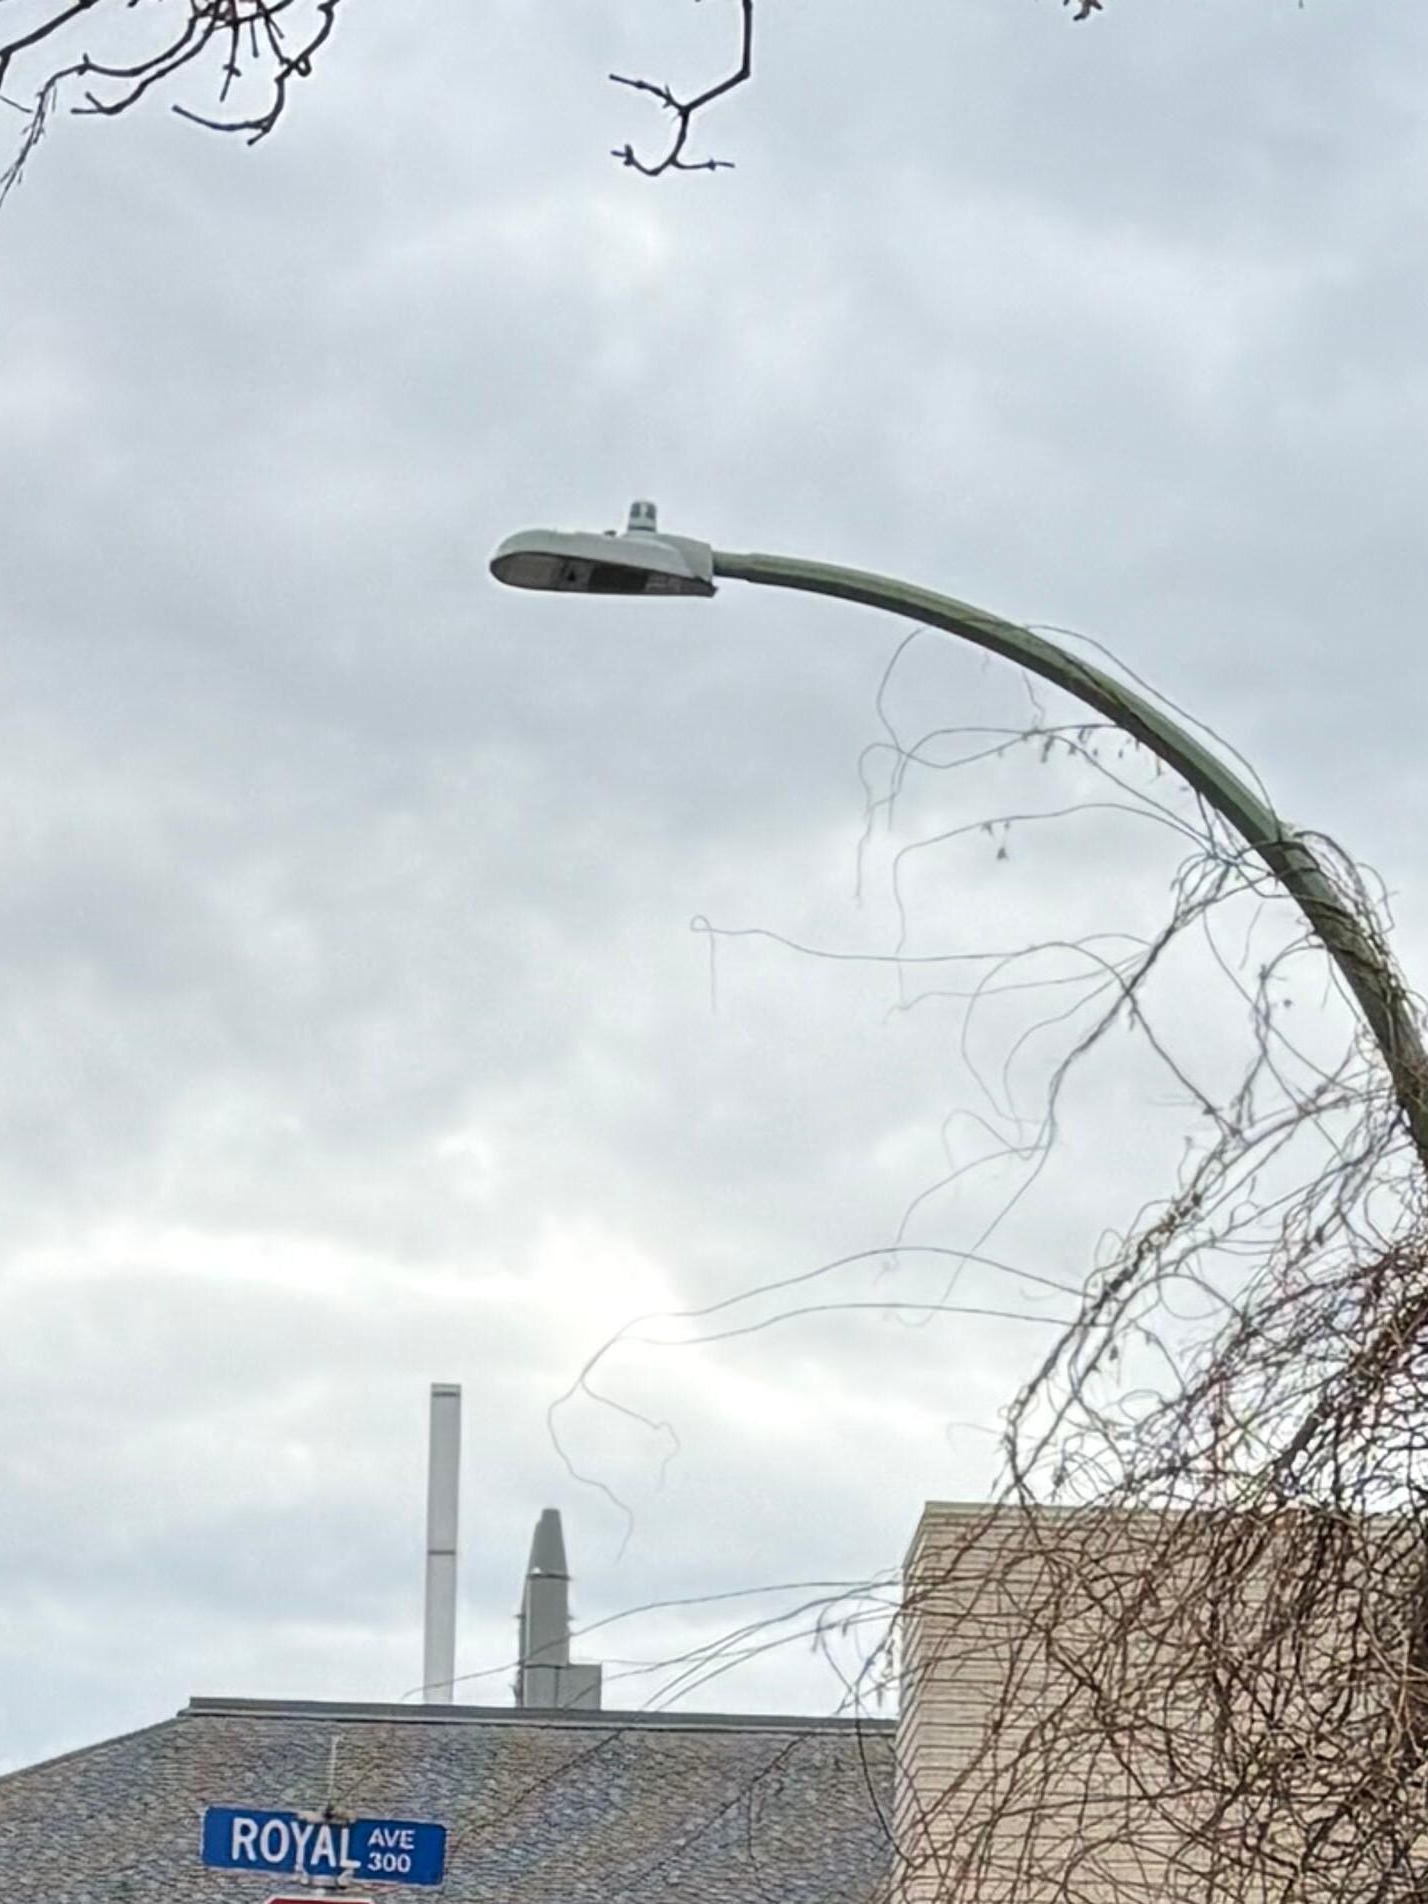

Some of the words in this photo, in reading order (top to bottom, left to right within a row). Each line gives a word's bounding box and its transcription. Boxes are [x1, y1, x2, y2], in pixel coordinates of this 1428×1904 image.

[231, 1817, 361, 1869] ROYAL
[367, 1828, 415, 1850] AVE
[367, 1852, 412, 1874] 300
